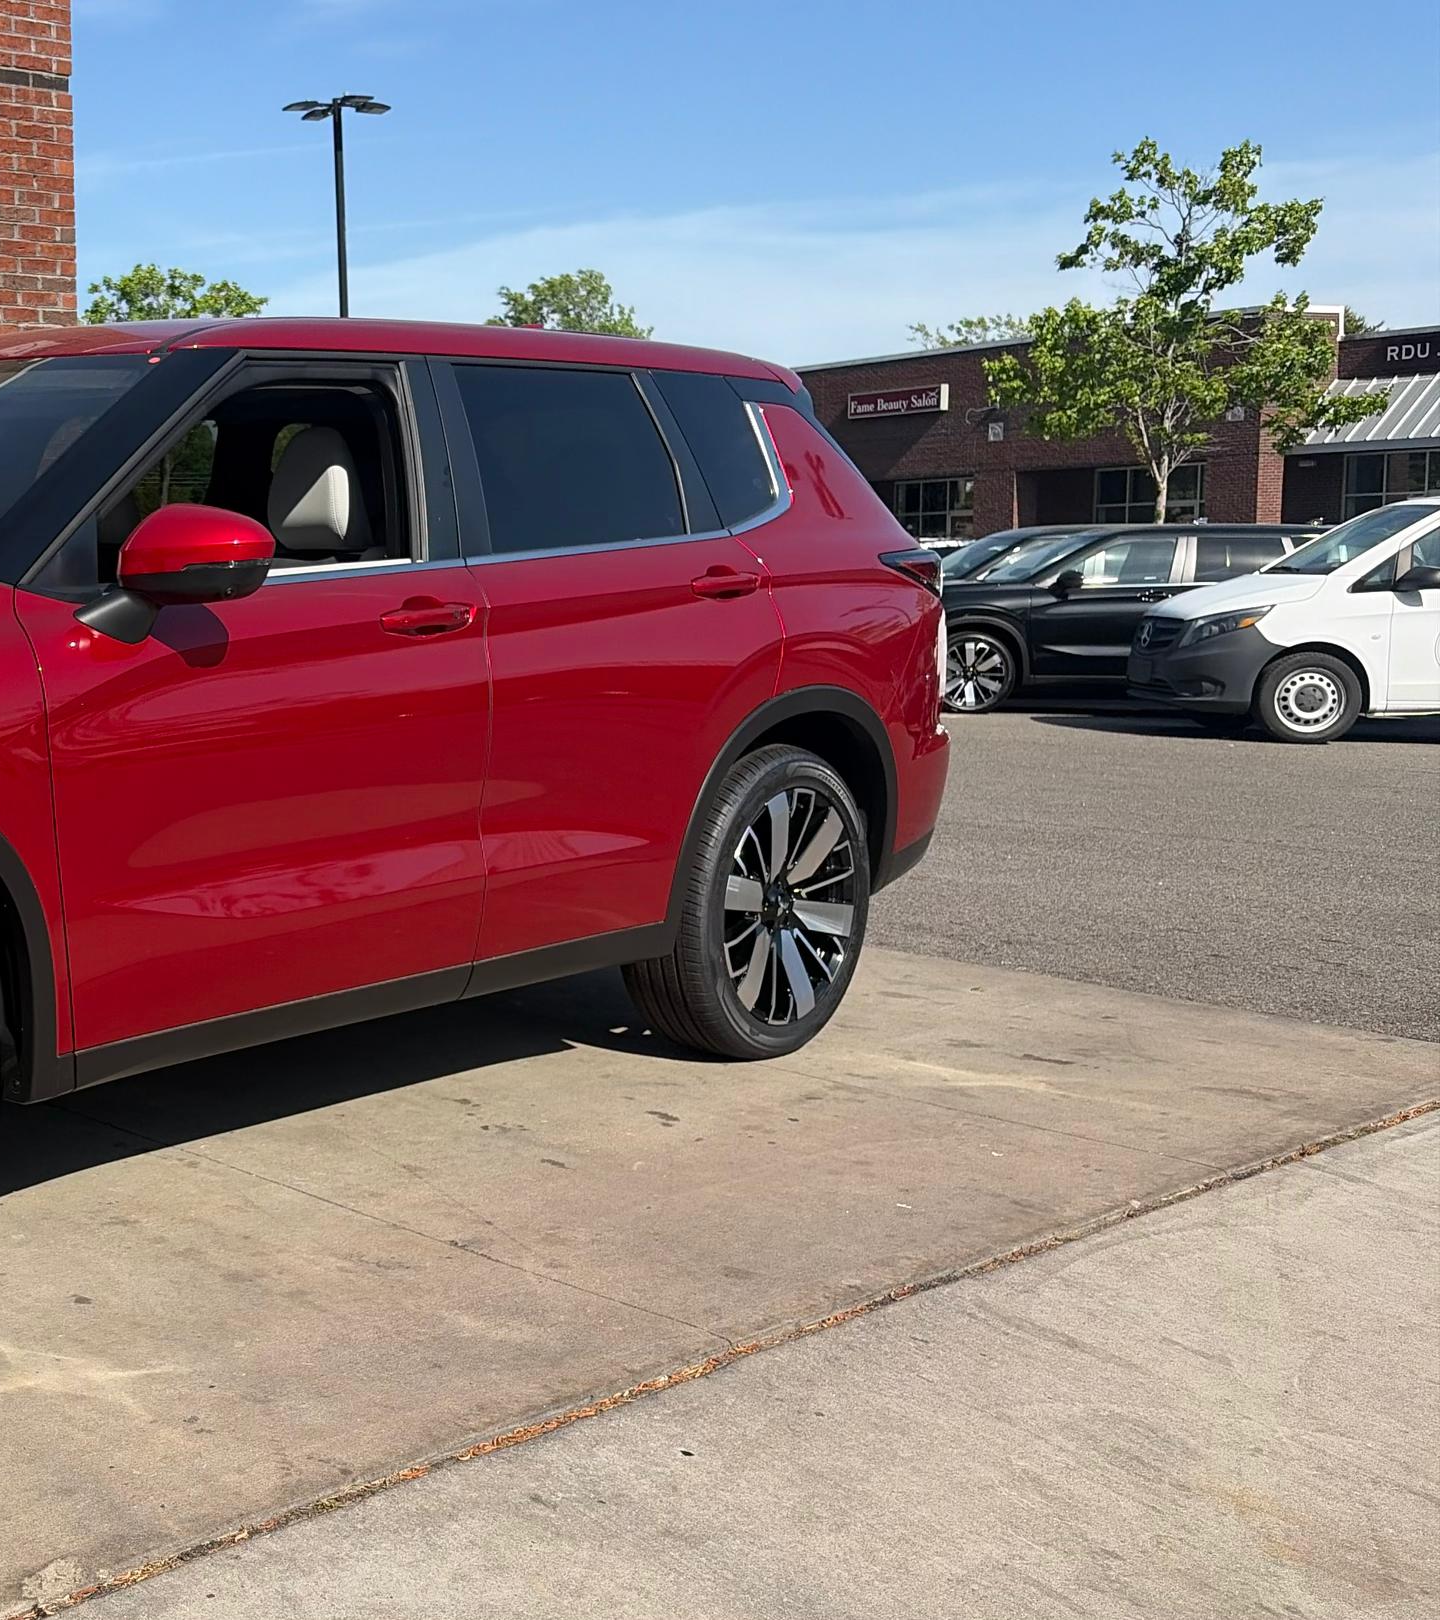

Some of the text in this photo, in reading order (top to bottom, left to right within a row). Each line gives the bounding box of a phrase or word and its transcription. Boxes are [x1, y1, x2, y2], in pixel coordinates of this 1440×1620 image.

[1387, 342, 1430, 361] RDU
[850, 393, 938, 414] Fame Beauty Salon
